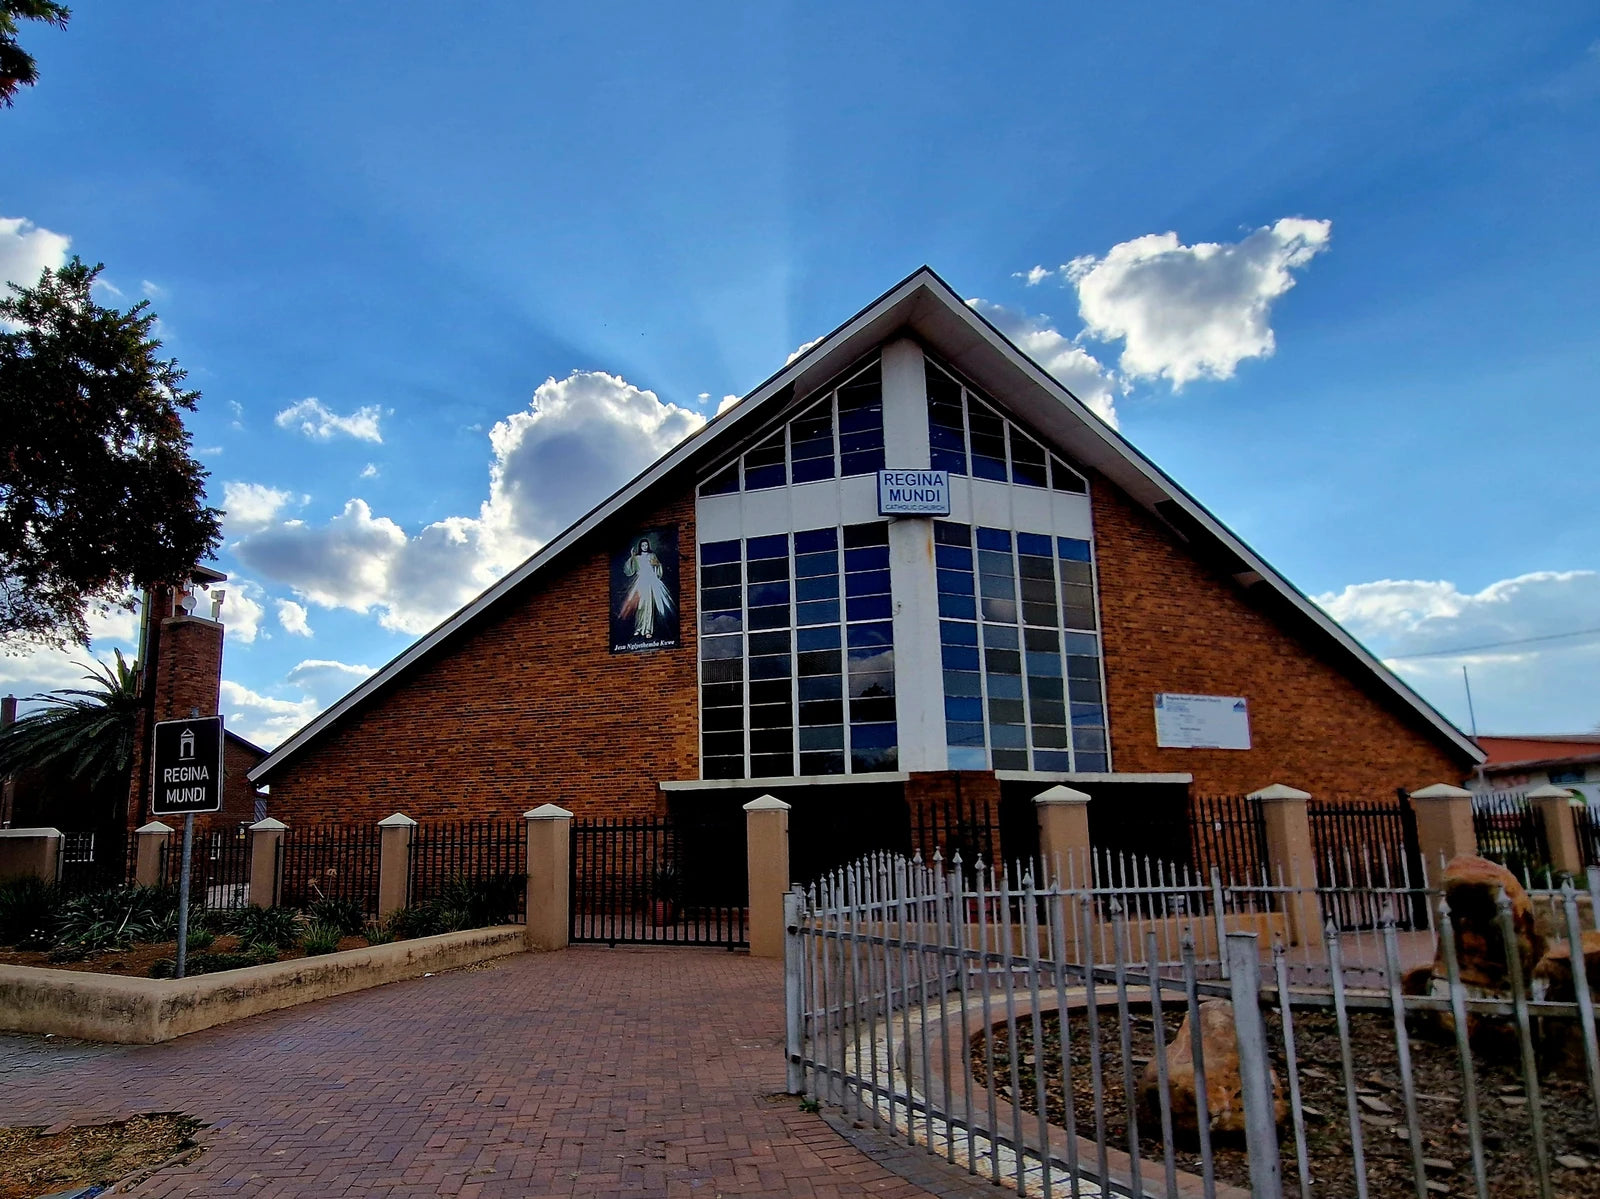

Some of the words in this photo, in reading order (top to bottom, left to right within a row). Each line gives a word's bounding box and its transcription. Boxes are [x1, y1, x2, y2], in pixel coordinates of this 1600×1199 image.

[884, 473, 944, 486] REGINA
[889, 489, 940, 502] MUNDI
[164, 765, 209, 783] REGINA
[166, 787, 206, 804] MUNDI
